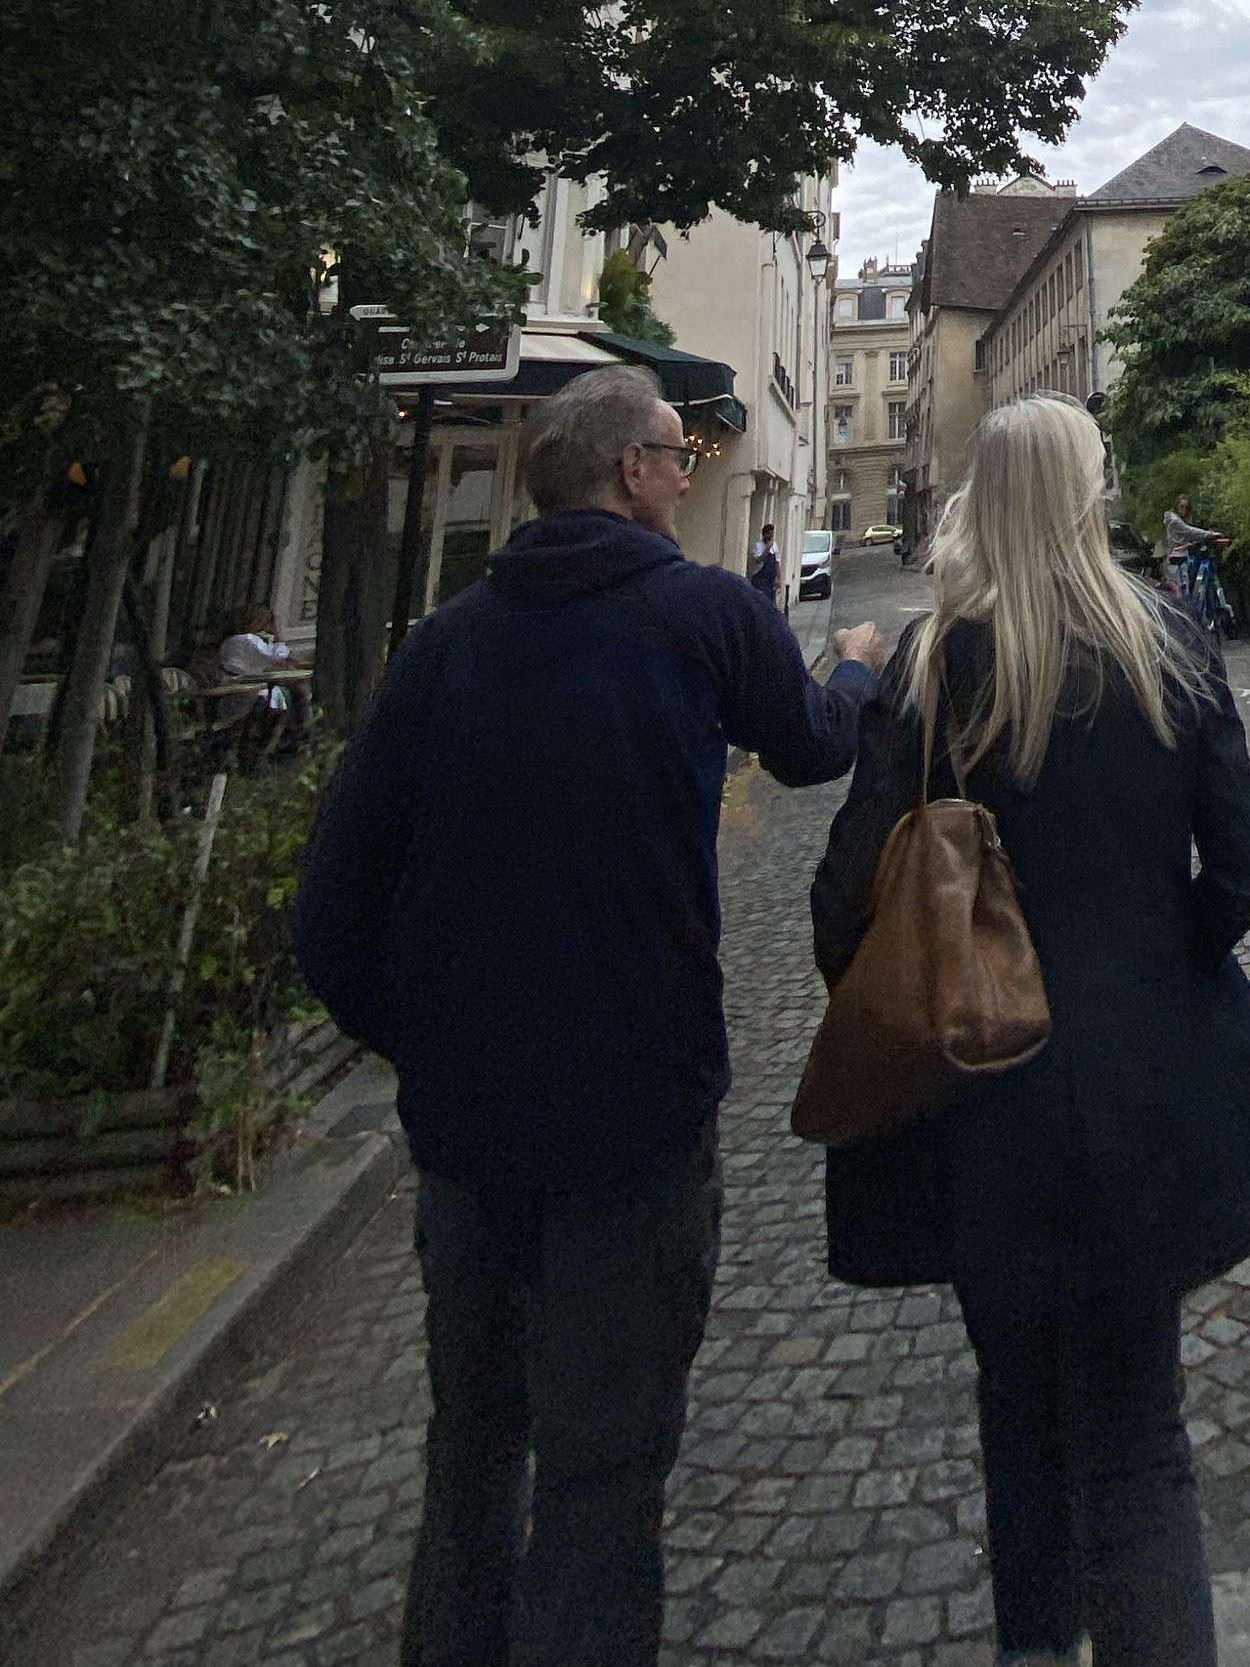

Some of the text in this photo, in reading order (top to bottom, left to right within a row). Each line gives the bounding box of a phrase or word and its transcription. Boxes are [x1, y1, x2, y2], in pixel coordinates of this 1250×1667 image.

[413, 352, 451, 365] Gervais
[455, 350, 467, 363] St
[469, 350, 503, 363] Protais
